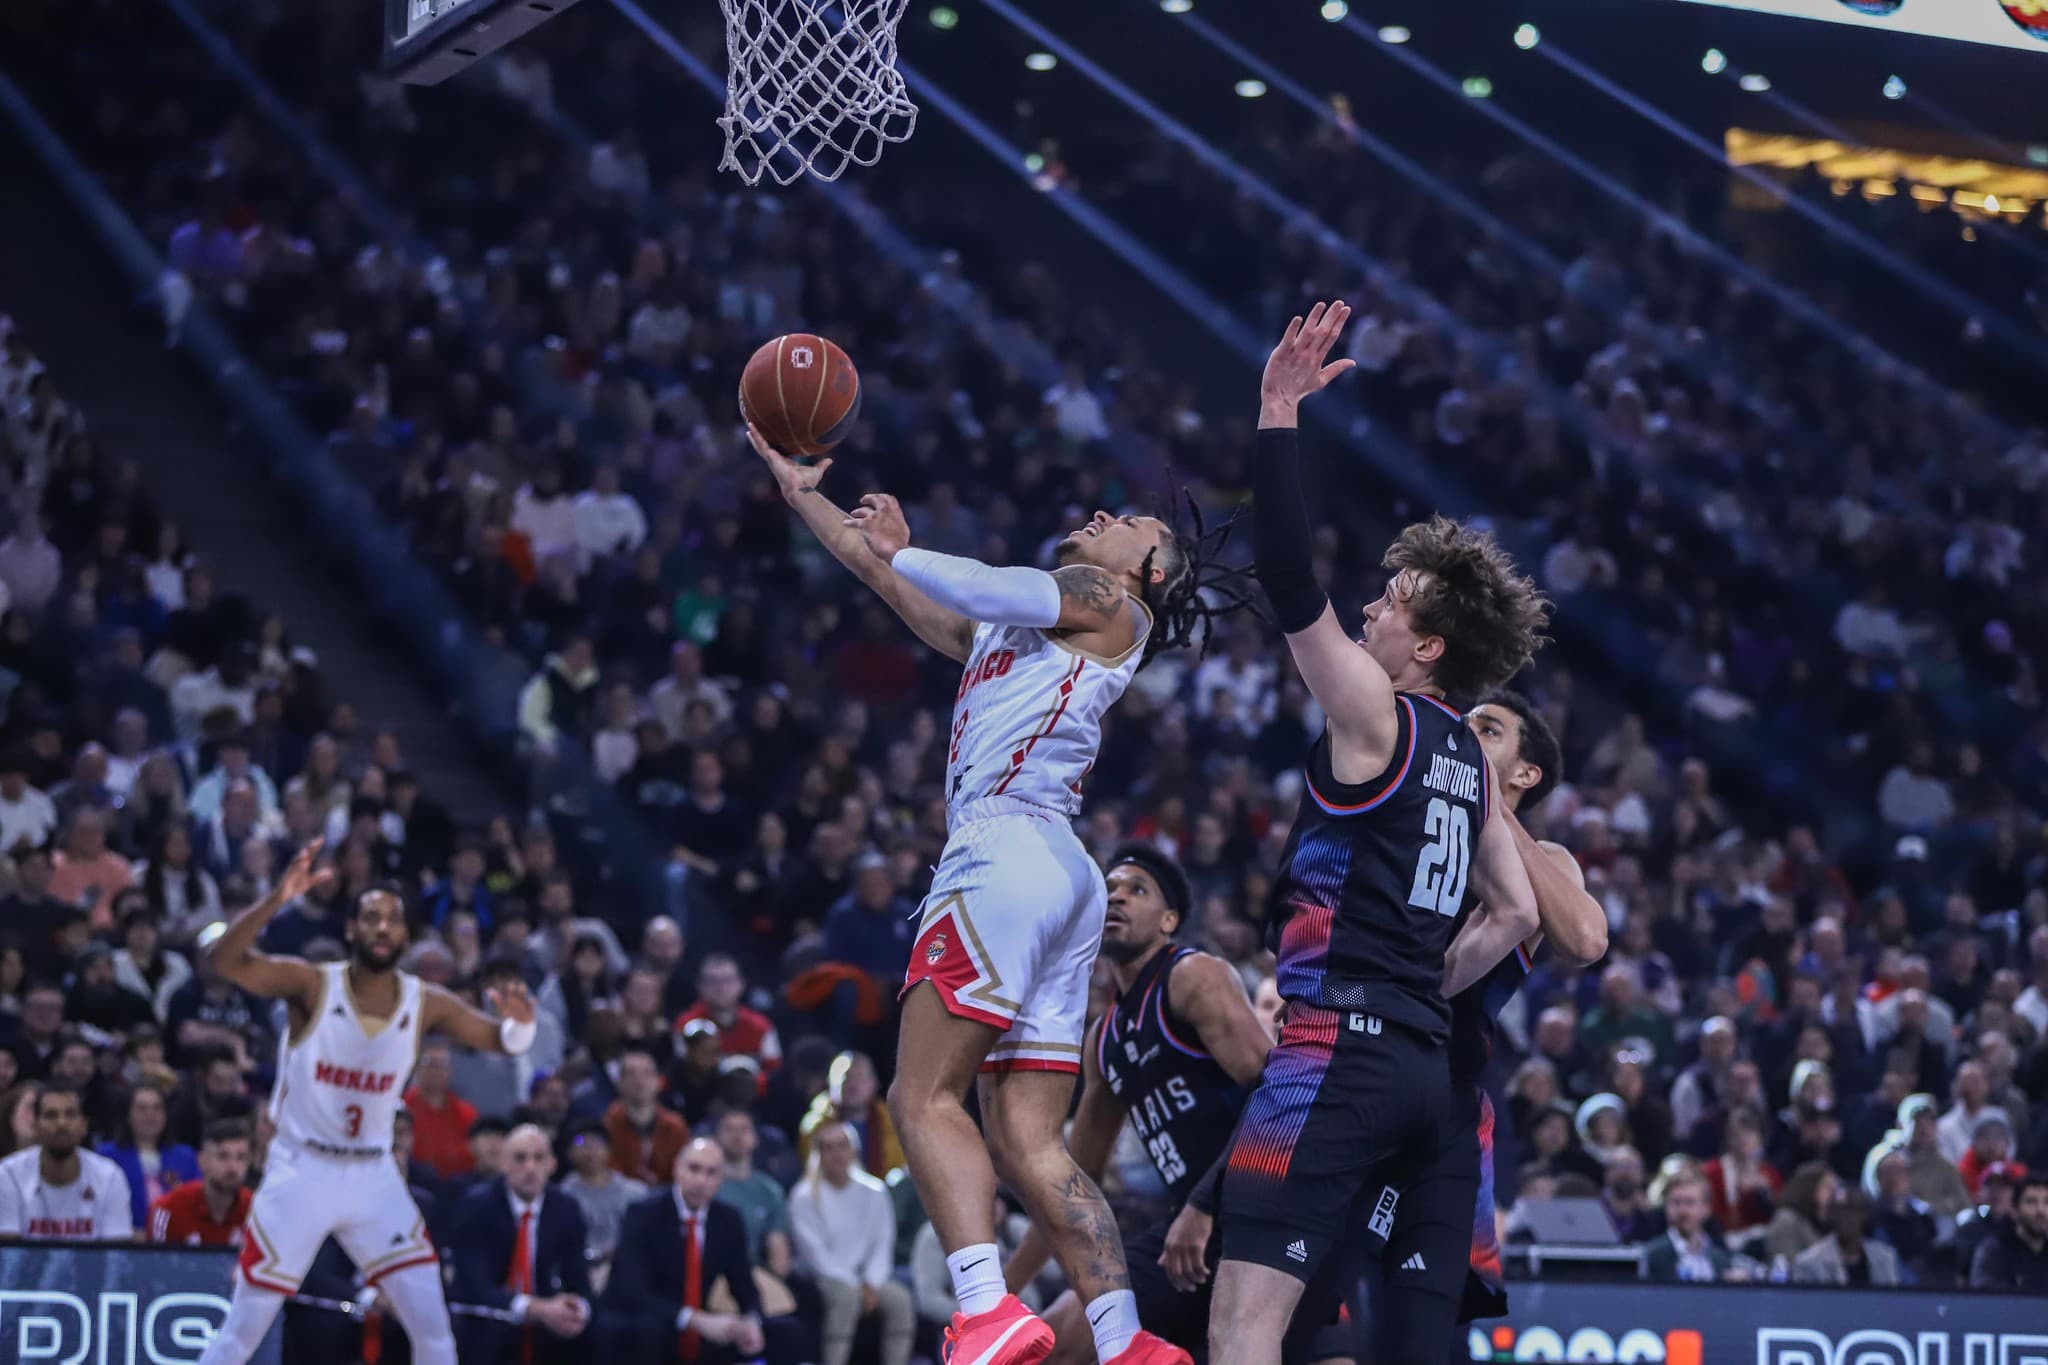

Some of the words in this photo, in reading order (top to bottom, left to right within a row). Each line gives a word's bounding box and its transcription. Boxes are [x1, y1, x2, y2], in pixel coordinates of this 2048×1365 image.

[1422, 753, 1480, 805] JANTUNE
[1407, 797, 1470, 918] 20
[344, 1104, 364, 1139] 3
[1131, 1076, 1197, 1139] ARIS
